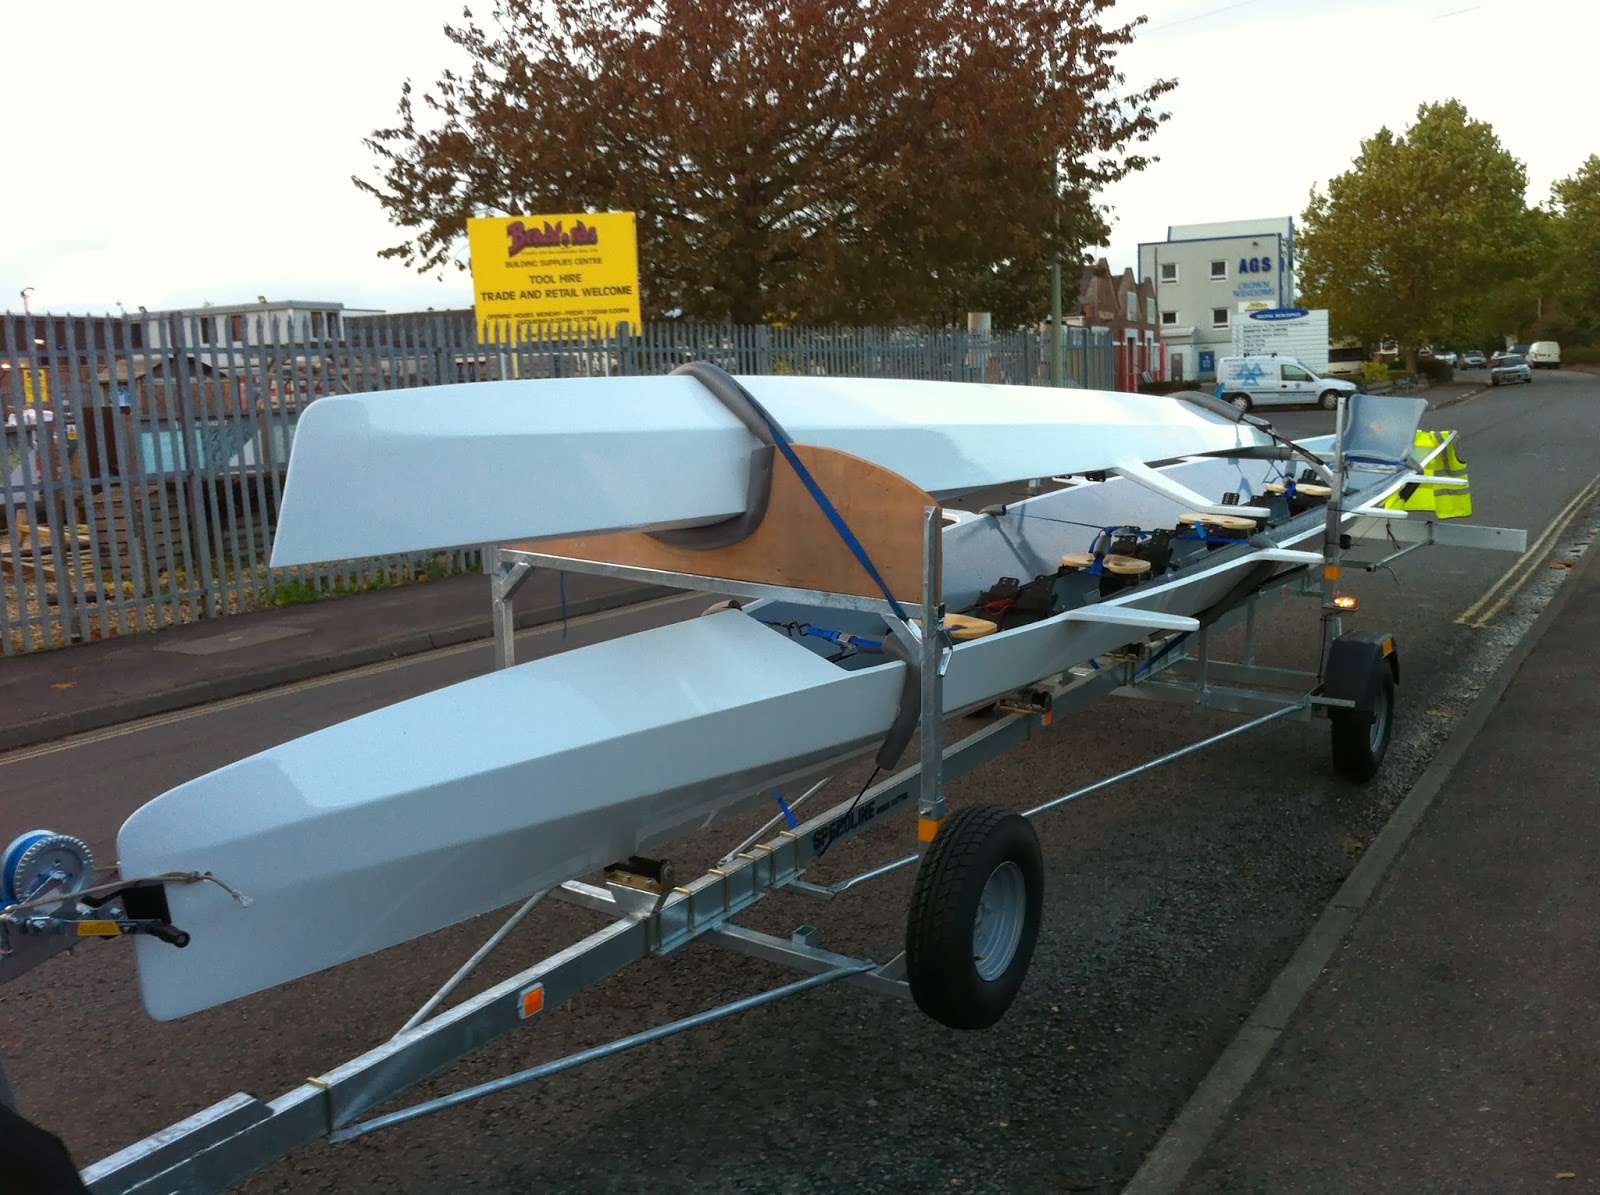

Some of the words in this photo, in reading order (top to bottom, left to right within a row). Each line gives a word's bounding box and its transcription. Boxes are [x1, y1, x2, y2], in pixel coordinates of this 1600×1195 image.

[505, 259, 538, 269] BUILDING
[540, 259, 573, 267] SUPPLIES
[574, 257, 603, 266] CENTRE
[1238, 256, 1272, 274] AGS
[529, 274, 556, 285] TOOL
[559, 273, 582, 284] HIRE
[481, 291, 516, 301] TRADE
[520, 290, 542, 300] AND
[545, 288, 579, 299] RETAIL
[582, 285, 632, 297] WELCOME
